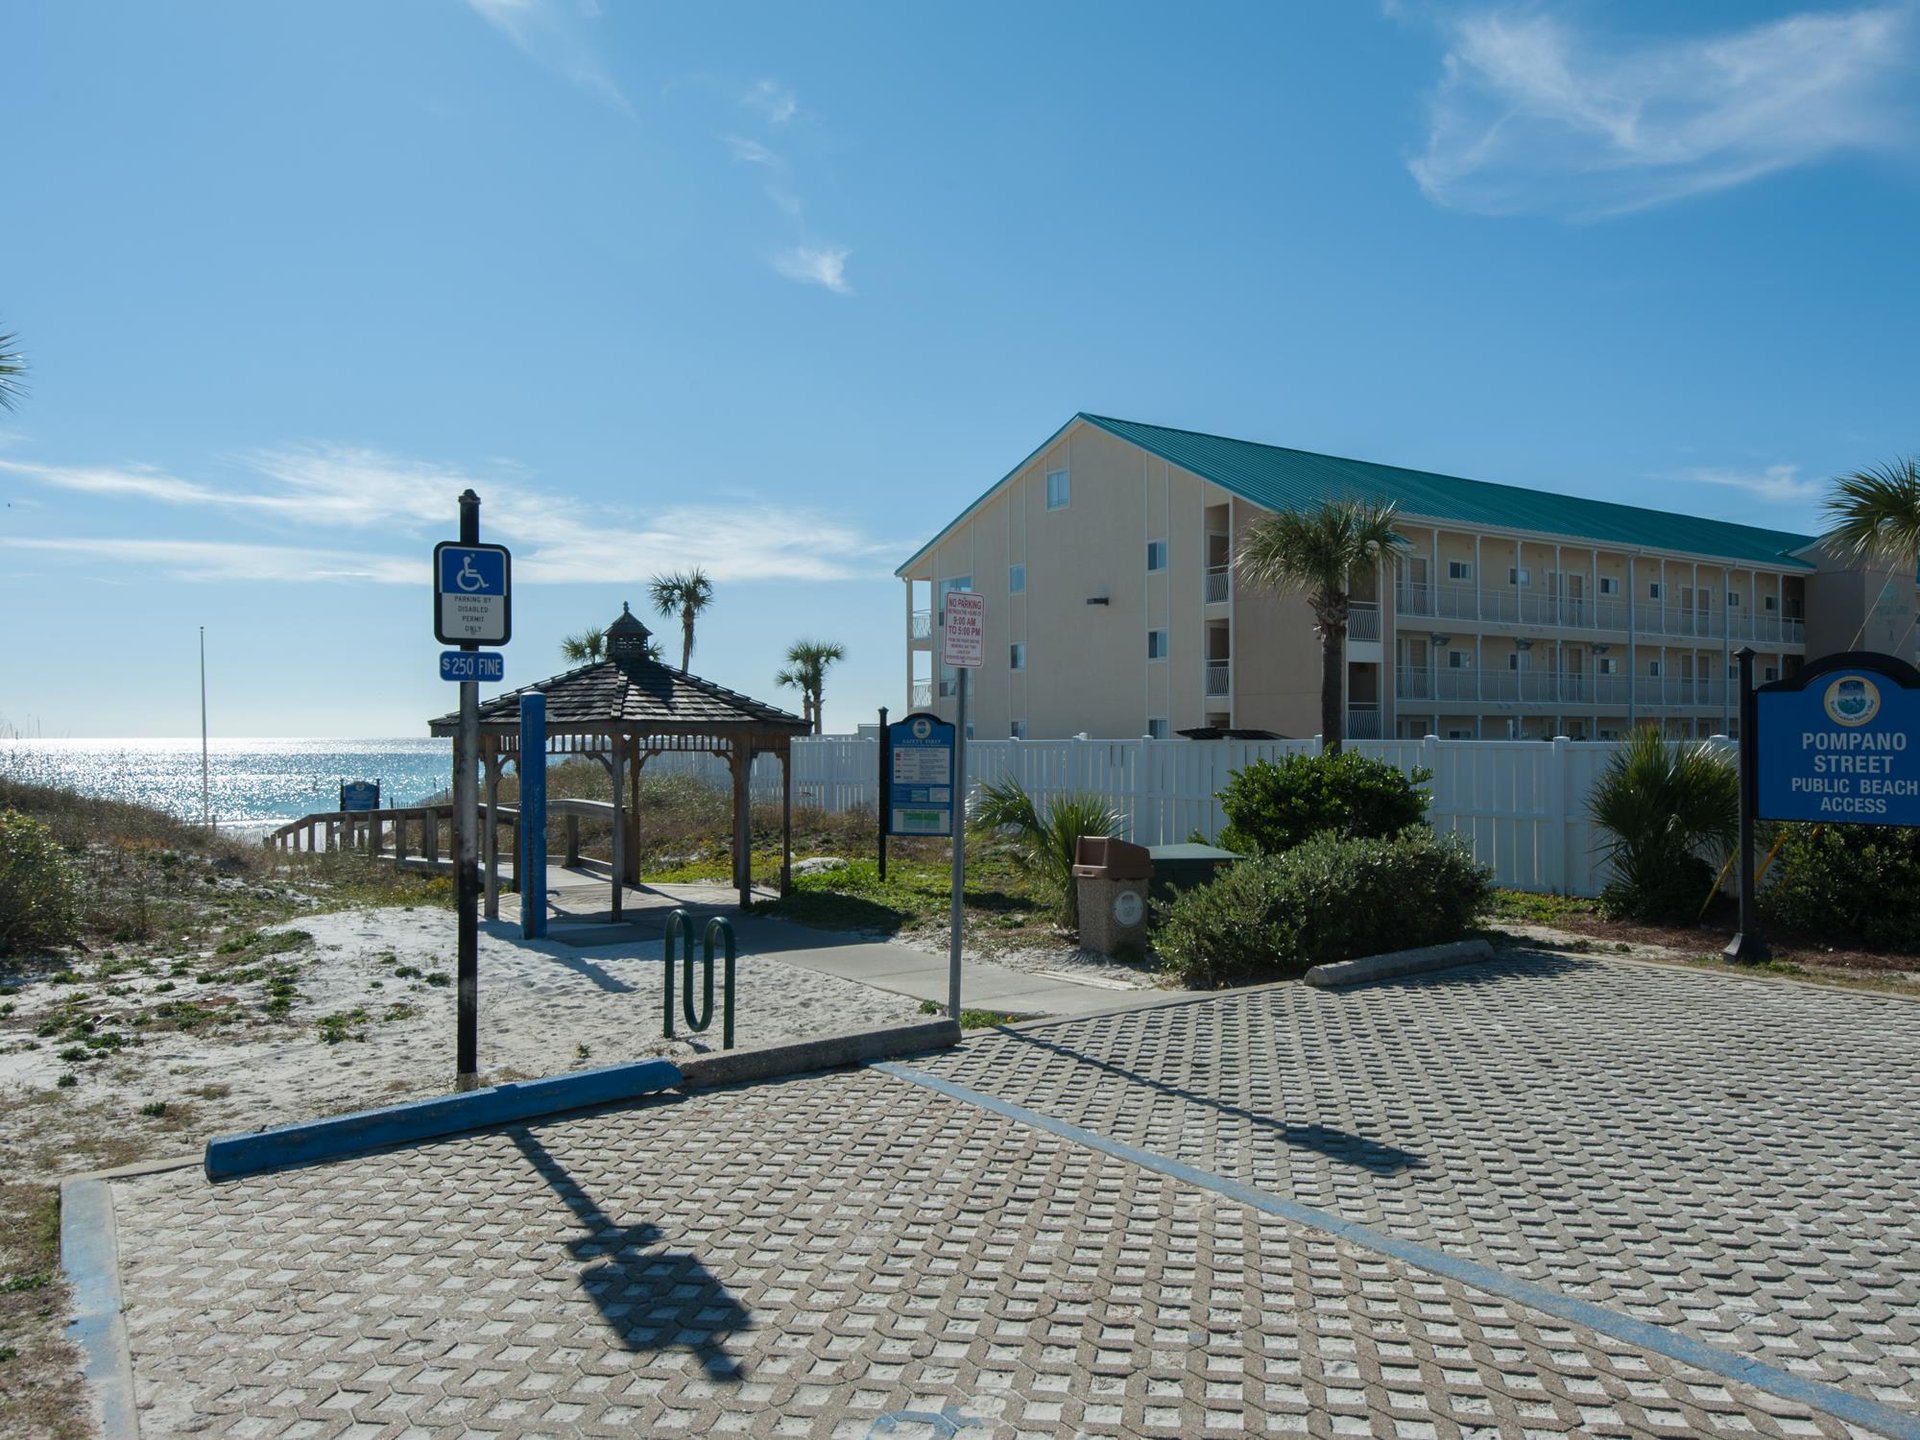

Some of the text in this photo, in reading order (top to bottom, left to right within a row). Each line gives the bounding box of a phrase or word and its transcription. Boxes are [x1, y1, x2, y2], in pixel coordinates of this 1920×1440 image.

[454, 595, 481, 603] PARKING
[949, 598, 982, 610] NO PARKING
[457, 605, 488, 613] DISABLED
[967, 617, 976, 627] AM
[464, 625, 482, 633] ONLY
[948, 625, 981, 637] TO 5:00 PM
[442, 657, 502, 676] $250 FINE
[1802, 732, 1907, 751] POMPANO
[1813, 755, 1894, 774] STREET
[1791, 777, 1919, 796] PUBLIC BEACH
[1819, 796, 1887, 814] ACCESS
